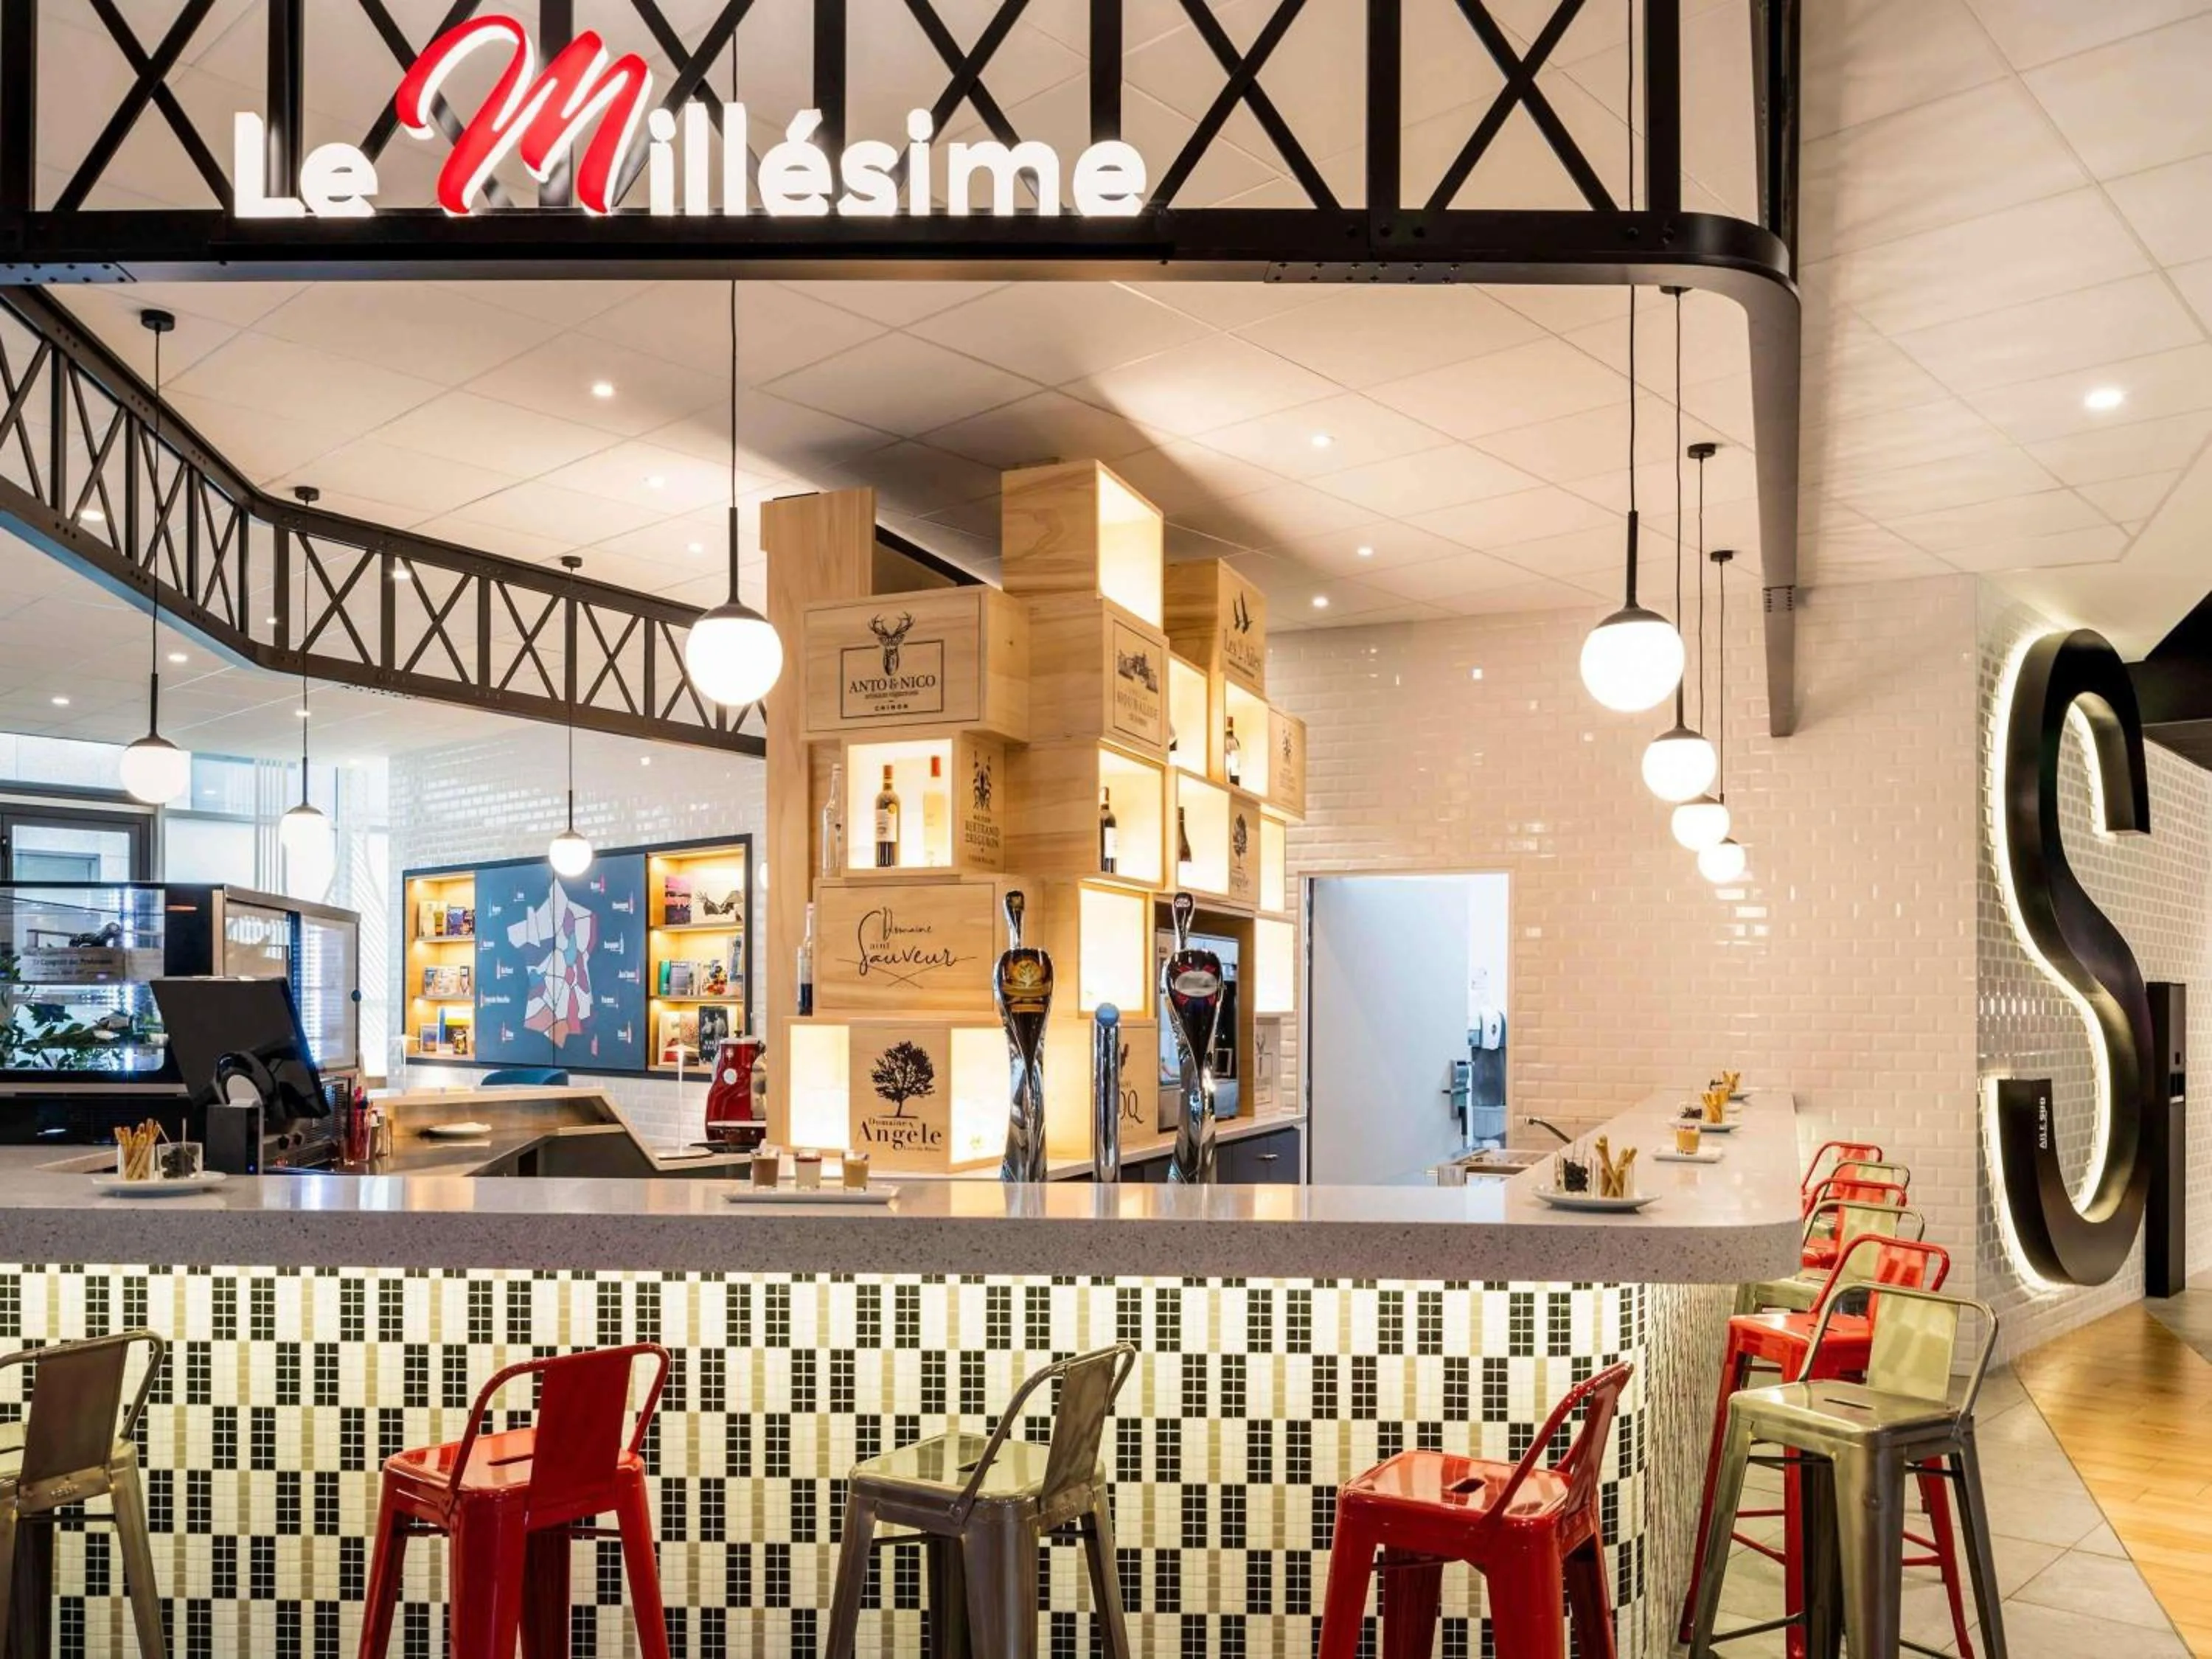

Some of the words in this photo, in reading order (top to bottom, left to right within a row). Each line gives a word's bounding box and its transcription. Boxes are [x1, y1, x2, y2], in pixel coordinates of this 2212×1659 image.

[234, 111, 378, 218] Le
[397, 15, 1147, 218] Millésime
[849, 678, 887, 693] ANTO
[900, 675, 936, 689] NICO
[883, 907, 933, 940] Domaine
